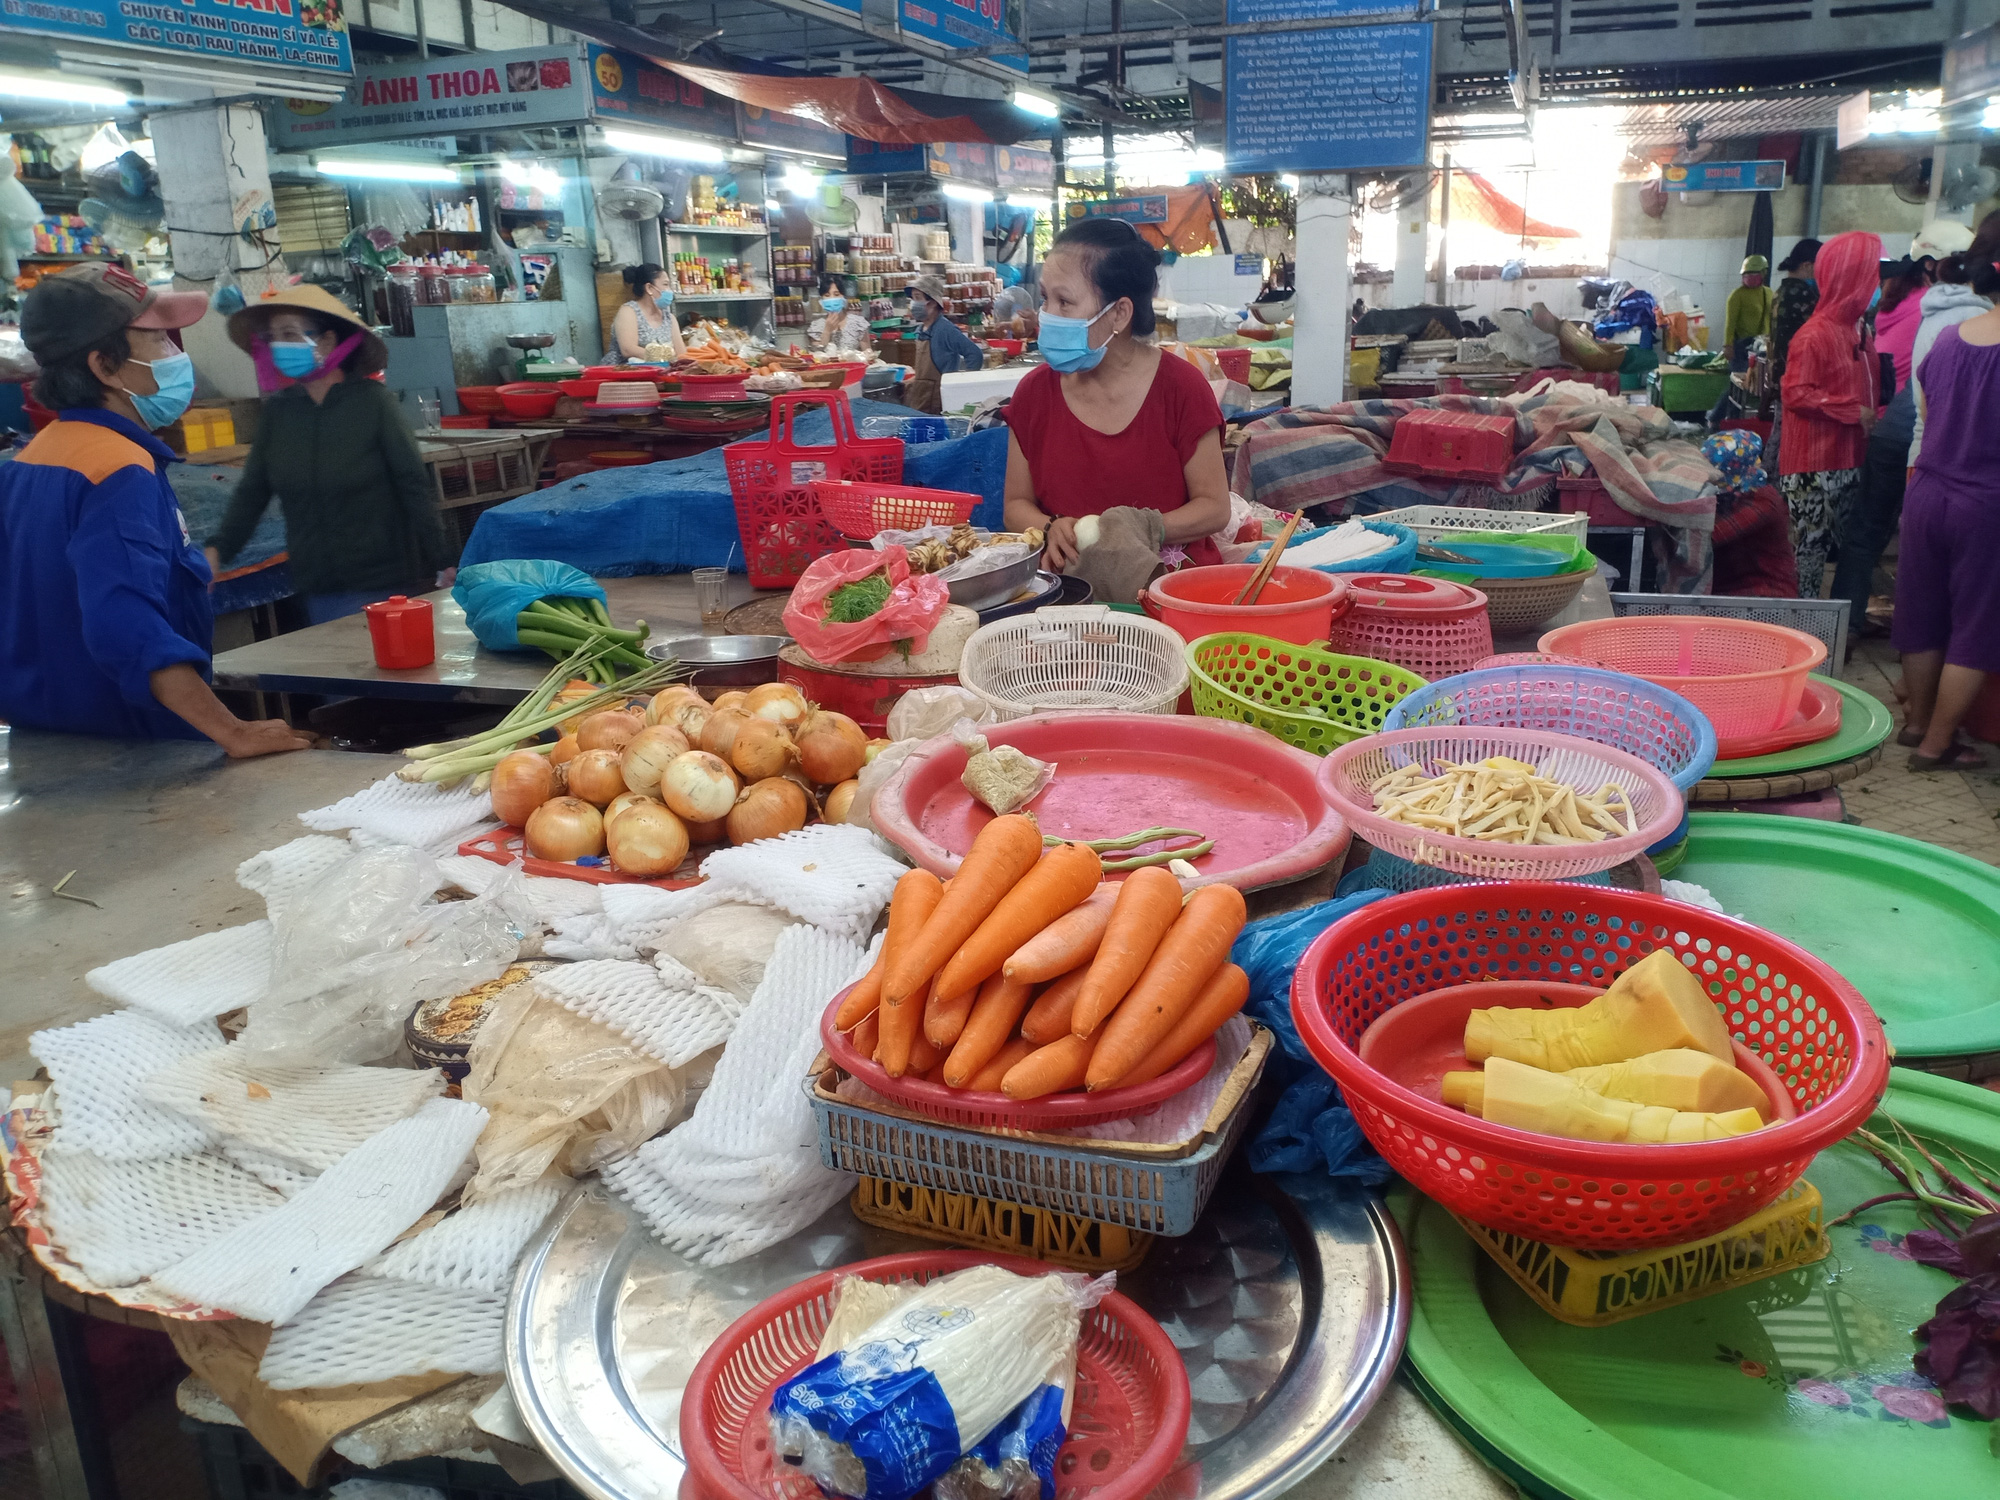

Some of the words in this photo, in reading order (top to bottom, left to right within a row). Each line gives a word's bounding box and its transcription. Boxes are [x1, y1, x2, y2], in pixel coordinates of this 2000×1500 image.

[120, 2, 186, 23] CHUYÊN
[190, 13, 227, 31] KINH
[231, 21, 279, 39] DOANH
[300, 30, 317, 45] VÀ
[128, 23, 161, 40] CÁC
[166, 30, 201, 48] LOẠI
[205, 36, 234, 51] RAU
[239, 41, 281, 59] HÀNH,
[285, 48, 340, 66] LA-GHIM
[427, 68, 501, 99] THOA
[602, 71, 618, 88] 50
